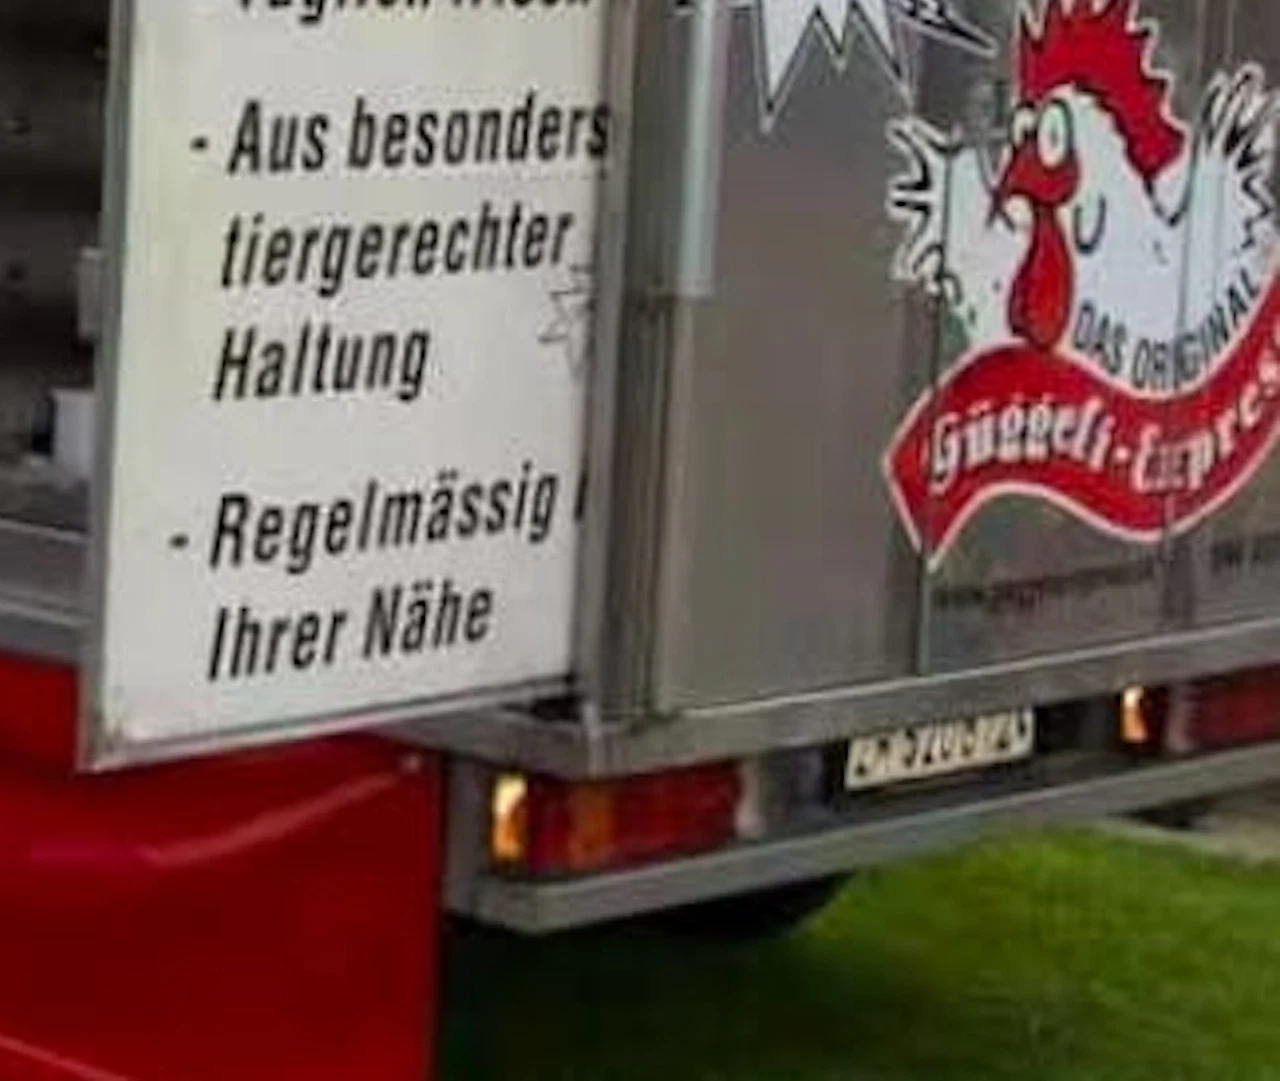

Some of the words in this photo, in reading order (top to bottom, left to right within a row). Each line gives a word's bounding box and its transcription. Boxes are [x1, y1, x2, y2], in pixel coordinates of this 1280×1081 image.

[227, 98, 329, 176] Aus
[347, 89, 611, 171] besonders
[220, 199, 575, 299] tiergerechter
[212, 322, 431, 403] Haltung
[1073, 298, 1127, 376] DAS
[1132, 265, 1261, 391] ORIGINAL
[209, 459, 560, 576] Regelmässig
[208, 606, 348, 682] Ihrer
[362, 579, 495, 659] Nähe
